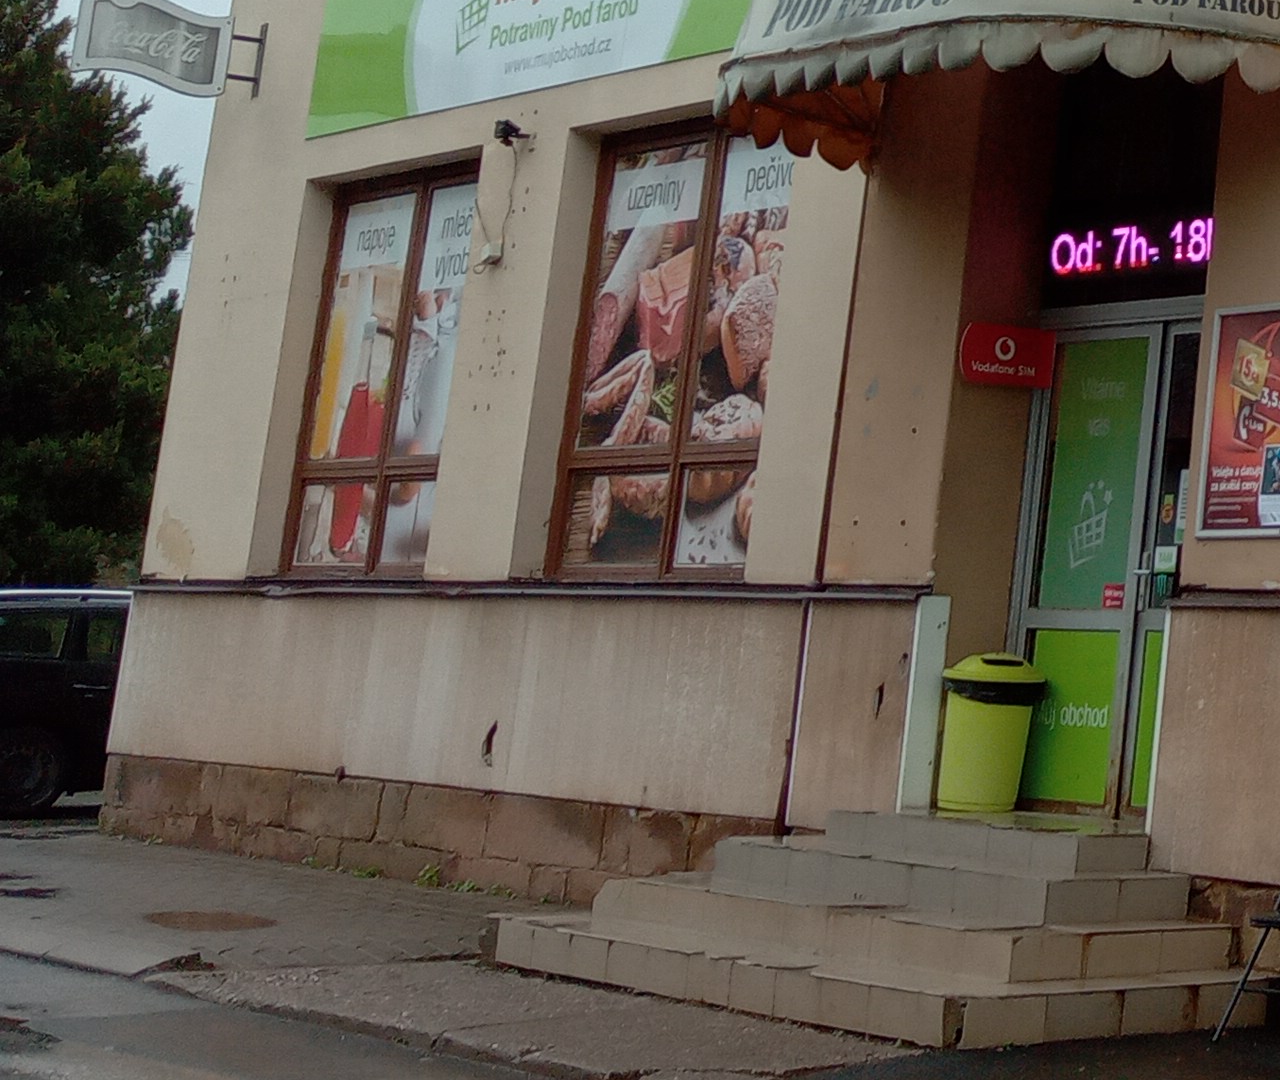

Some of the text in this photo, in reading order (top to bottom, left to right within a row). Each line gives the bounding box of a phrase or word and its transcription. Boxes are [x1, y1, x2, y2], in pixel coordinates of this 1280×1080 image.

[488, 14, 559, 49] Potraviny
[561, 1, 594, 32] Pod
[627, 175, 685, 211] uzeniny
[356, 221, 396, 258] nápoje
[441, 206, 475, 239] mléč
[435, 246, 470, 285] výrob
[1052, 230, 1102, 274] Od:
[971, 360, 1016, 375] Vodafone
[1060, 702, 1109, 729] obchod
